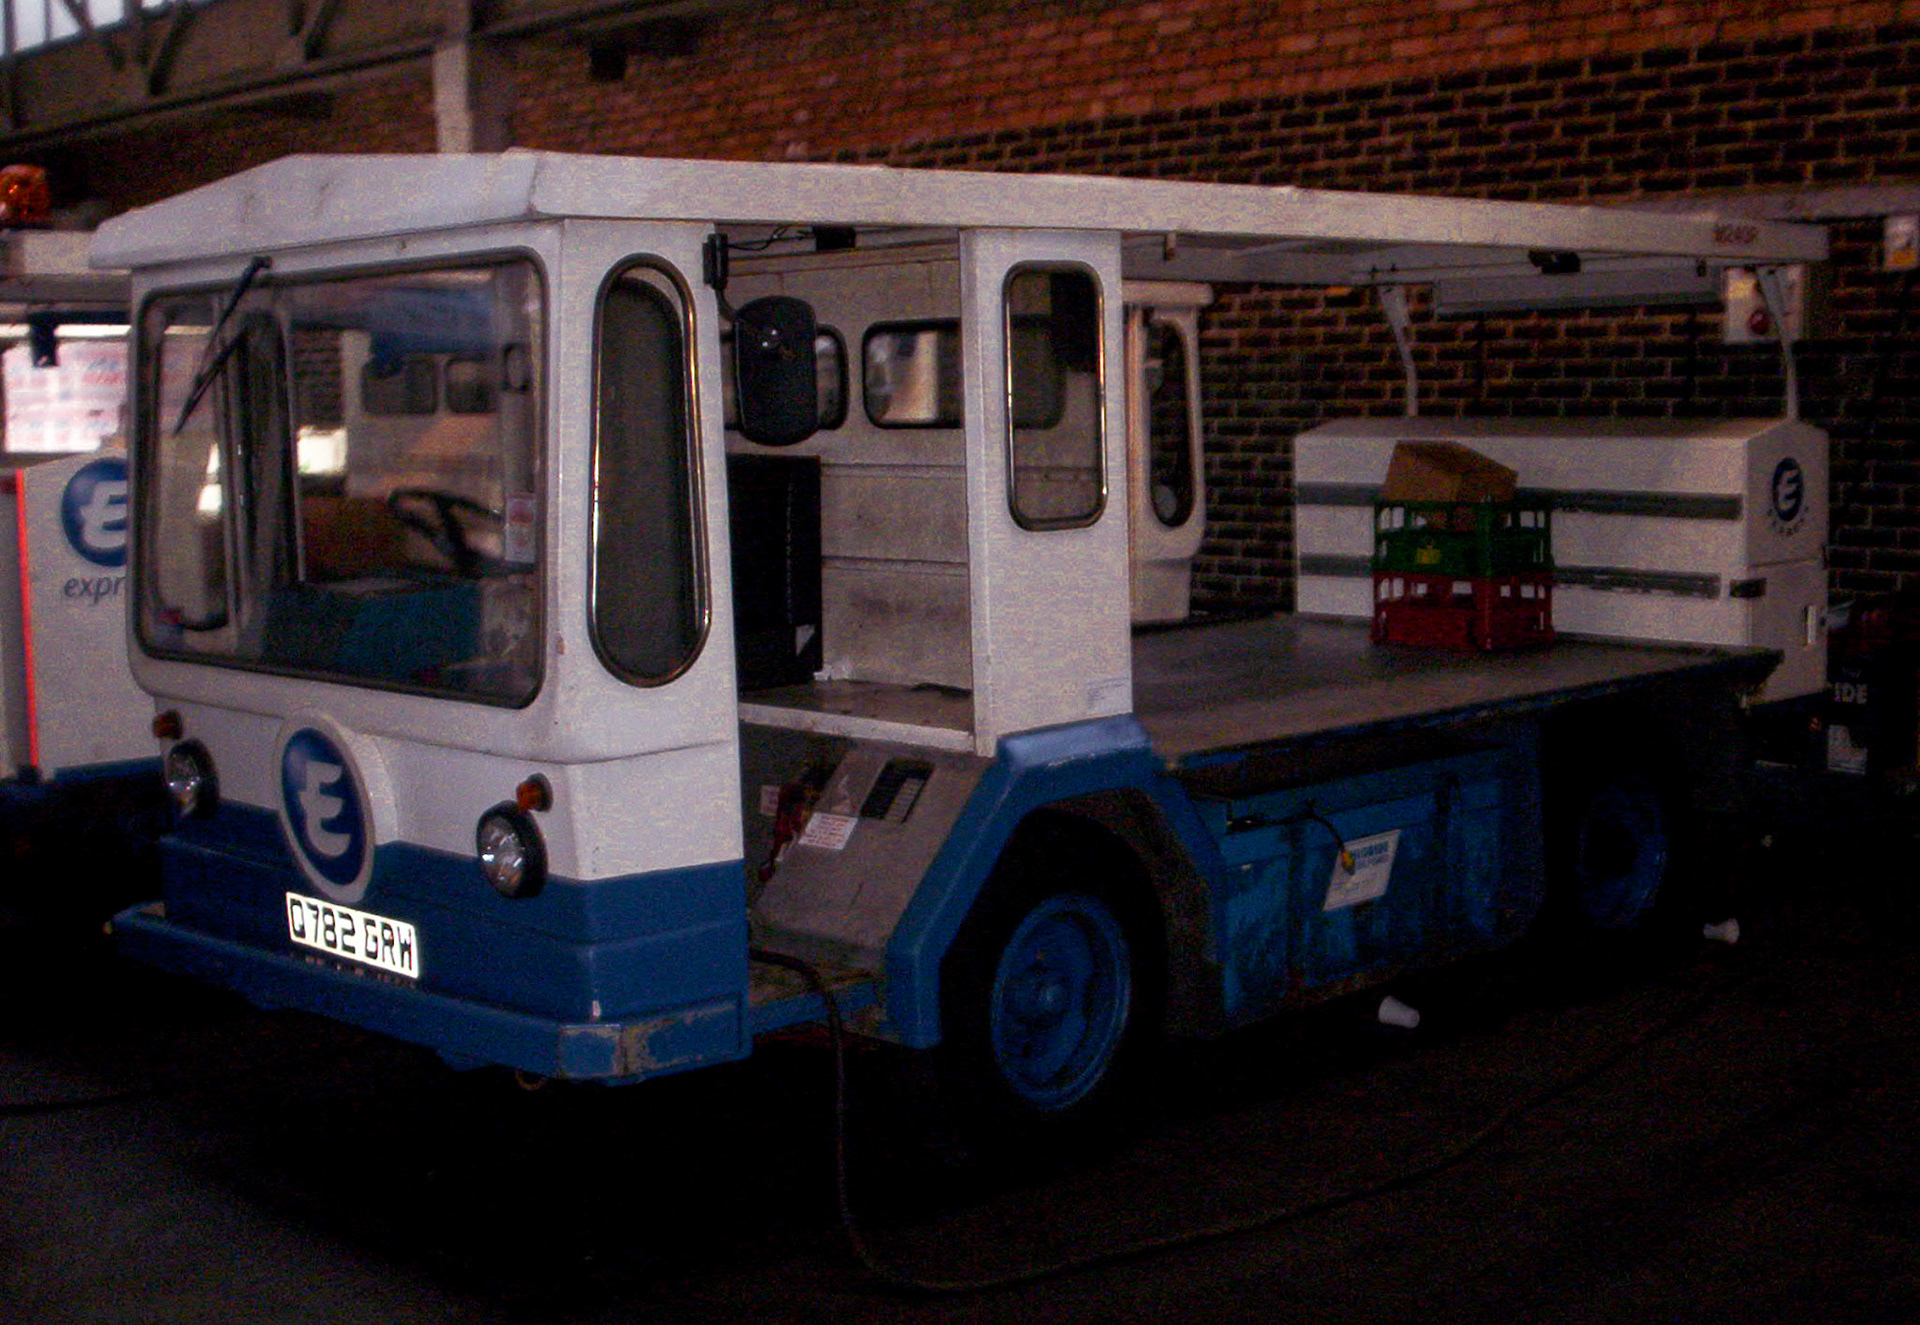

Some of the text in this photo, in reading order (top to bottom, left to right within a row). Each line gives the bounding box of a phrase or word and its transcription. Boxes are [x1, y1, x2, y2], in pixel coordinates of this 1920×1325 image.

[299, 760, 351, 857] E
[290, 898, 412, 971] Q782 GRW
